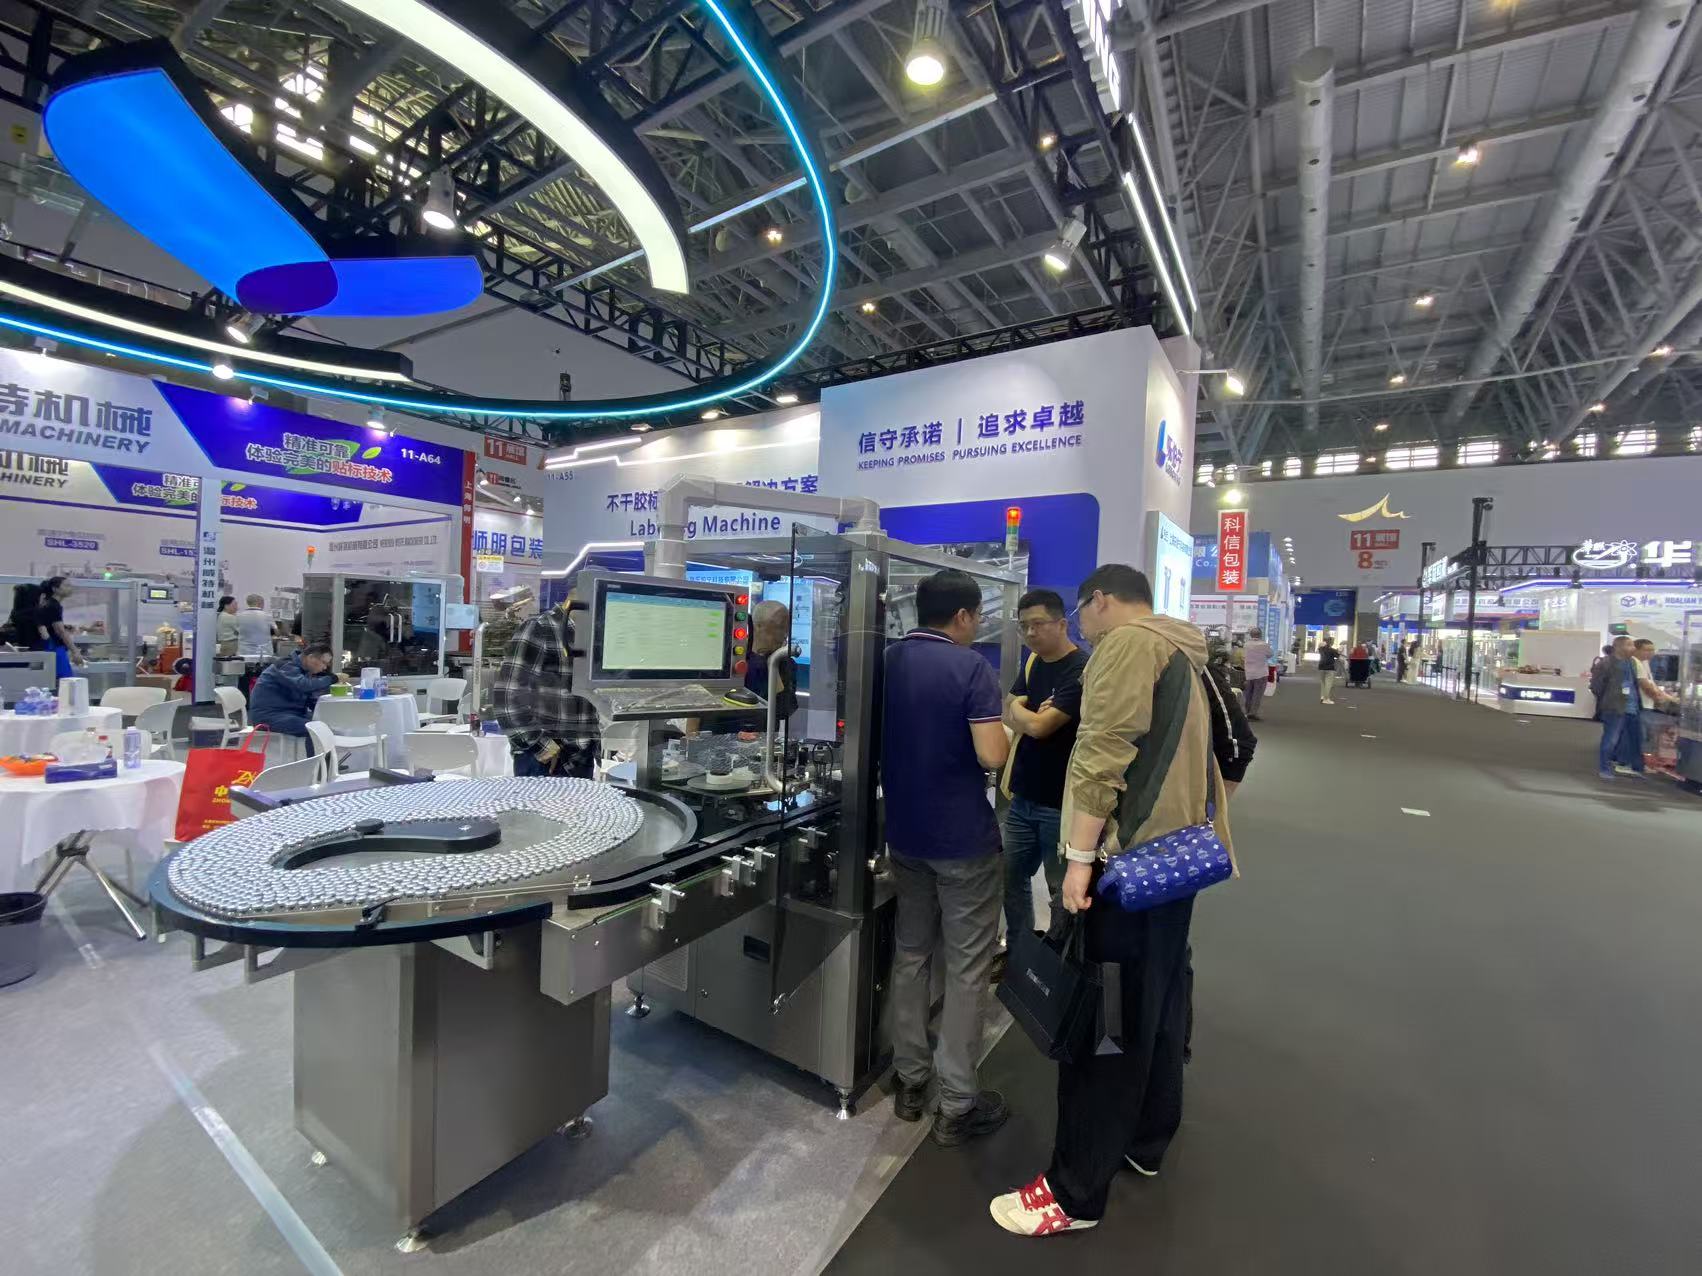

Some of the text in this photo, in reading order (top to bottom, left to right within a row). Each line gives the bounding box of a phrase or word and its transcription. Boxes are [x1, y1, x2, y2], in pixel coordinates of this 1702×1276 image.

[0, 418, 150, 454] MACHINERY
[858, 399, 1085, 455] 信守承诺 追求卓越
[283, 432, 351, 459] 精准可靠
[401, 448, 442, 465] 11-A64
[858, 434, 1082, 470] KEEPING PROMISES PURSUING EXCELLENCE
[246, 442, 393, 483] 体验完美的贴标技术
[702, 509, 781, 534] Machine
[473, 529, 543, 560] 师明包装
[1222, 516, 1241, 585] 科信包装
[1353, 533, 1372, 547] 11
[1358, 551, 1373, 568] 8
